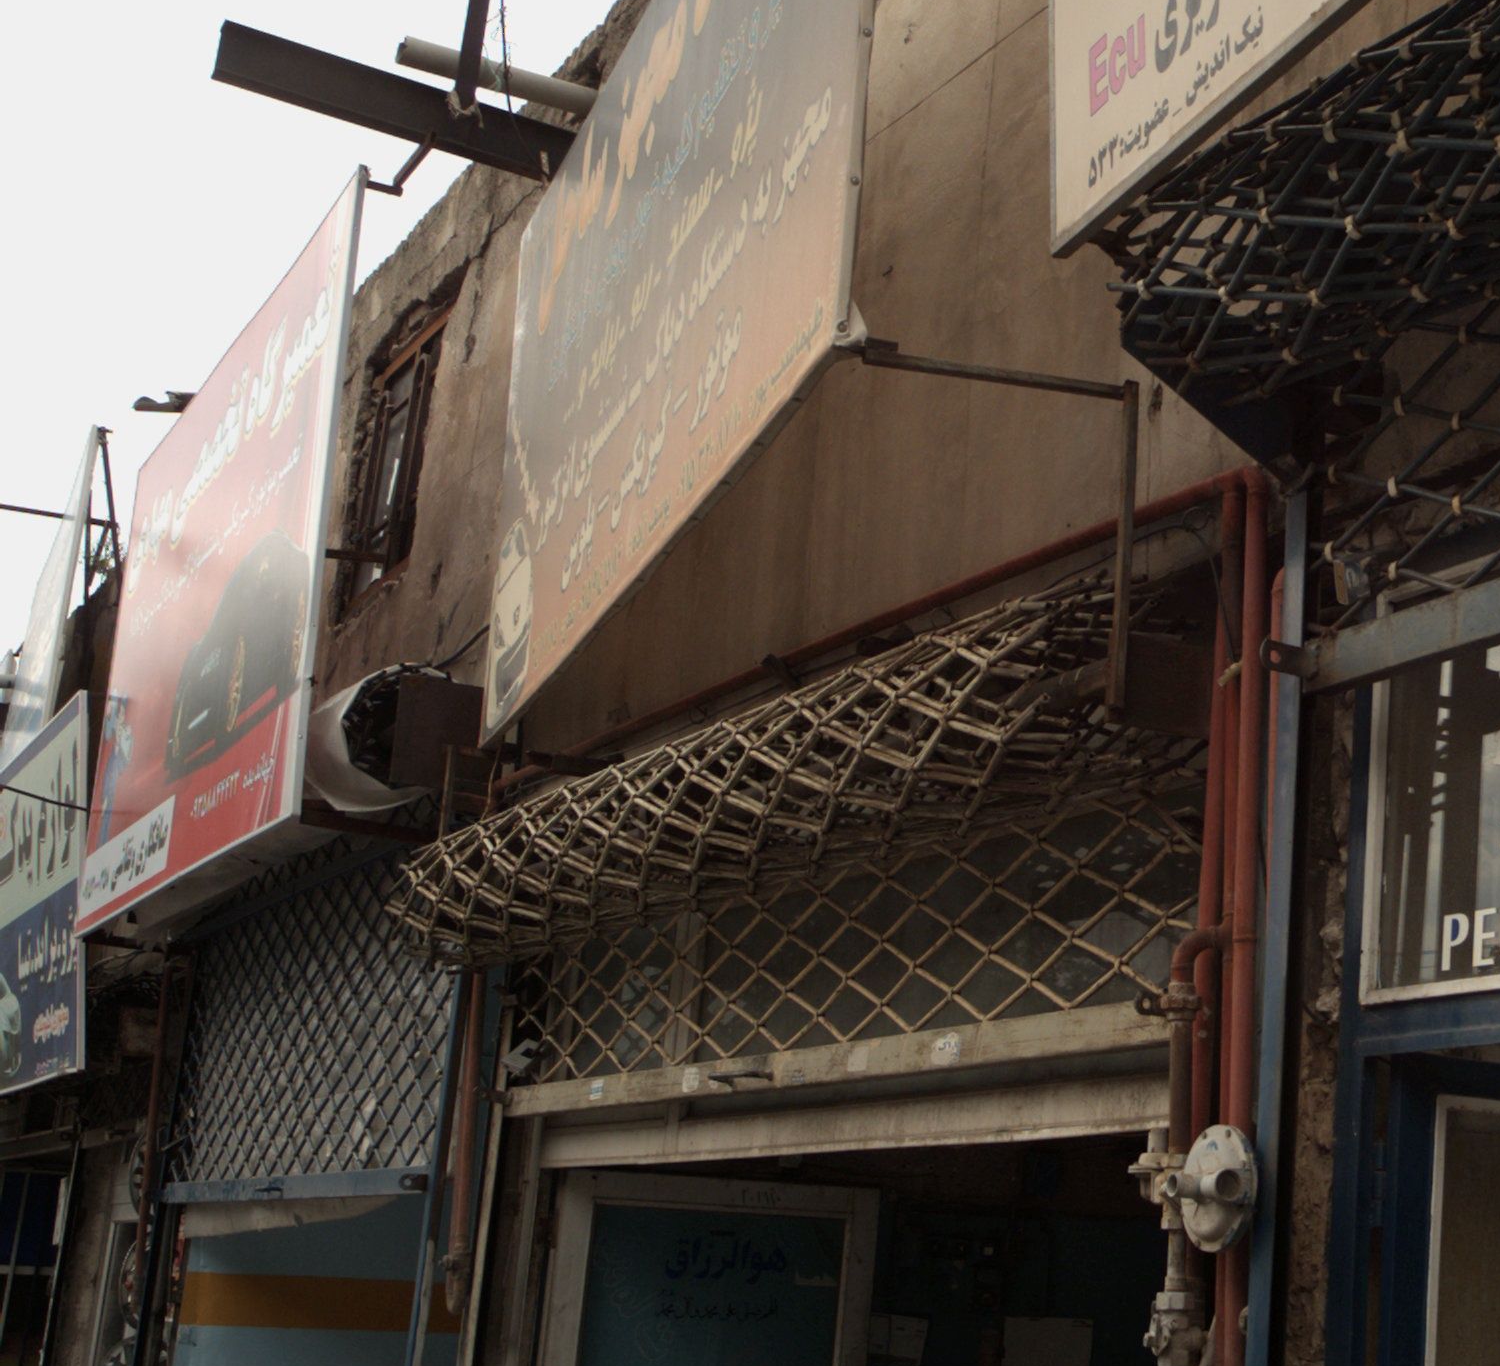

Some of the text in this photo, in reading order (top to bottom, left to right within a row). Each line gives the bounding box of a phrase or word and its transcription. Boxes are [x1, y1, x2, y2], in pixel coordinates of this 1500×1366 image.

[667, 167, 715, 268] سمند
[772, 87, 831, 223] مجهز
[537, 118, 609, 336] ساحل
[688, 198, 748, 320] دستگاه
[689, 305, 742, 433] موتور
